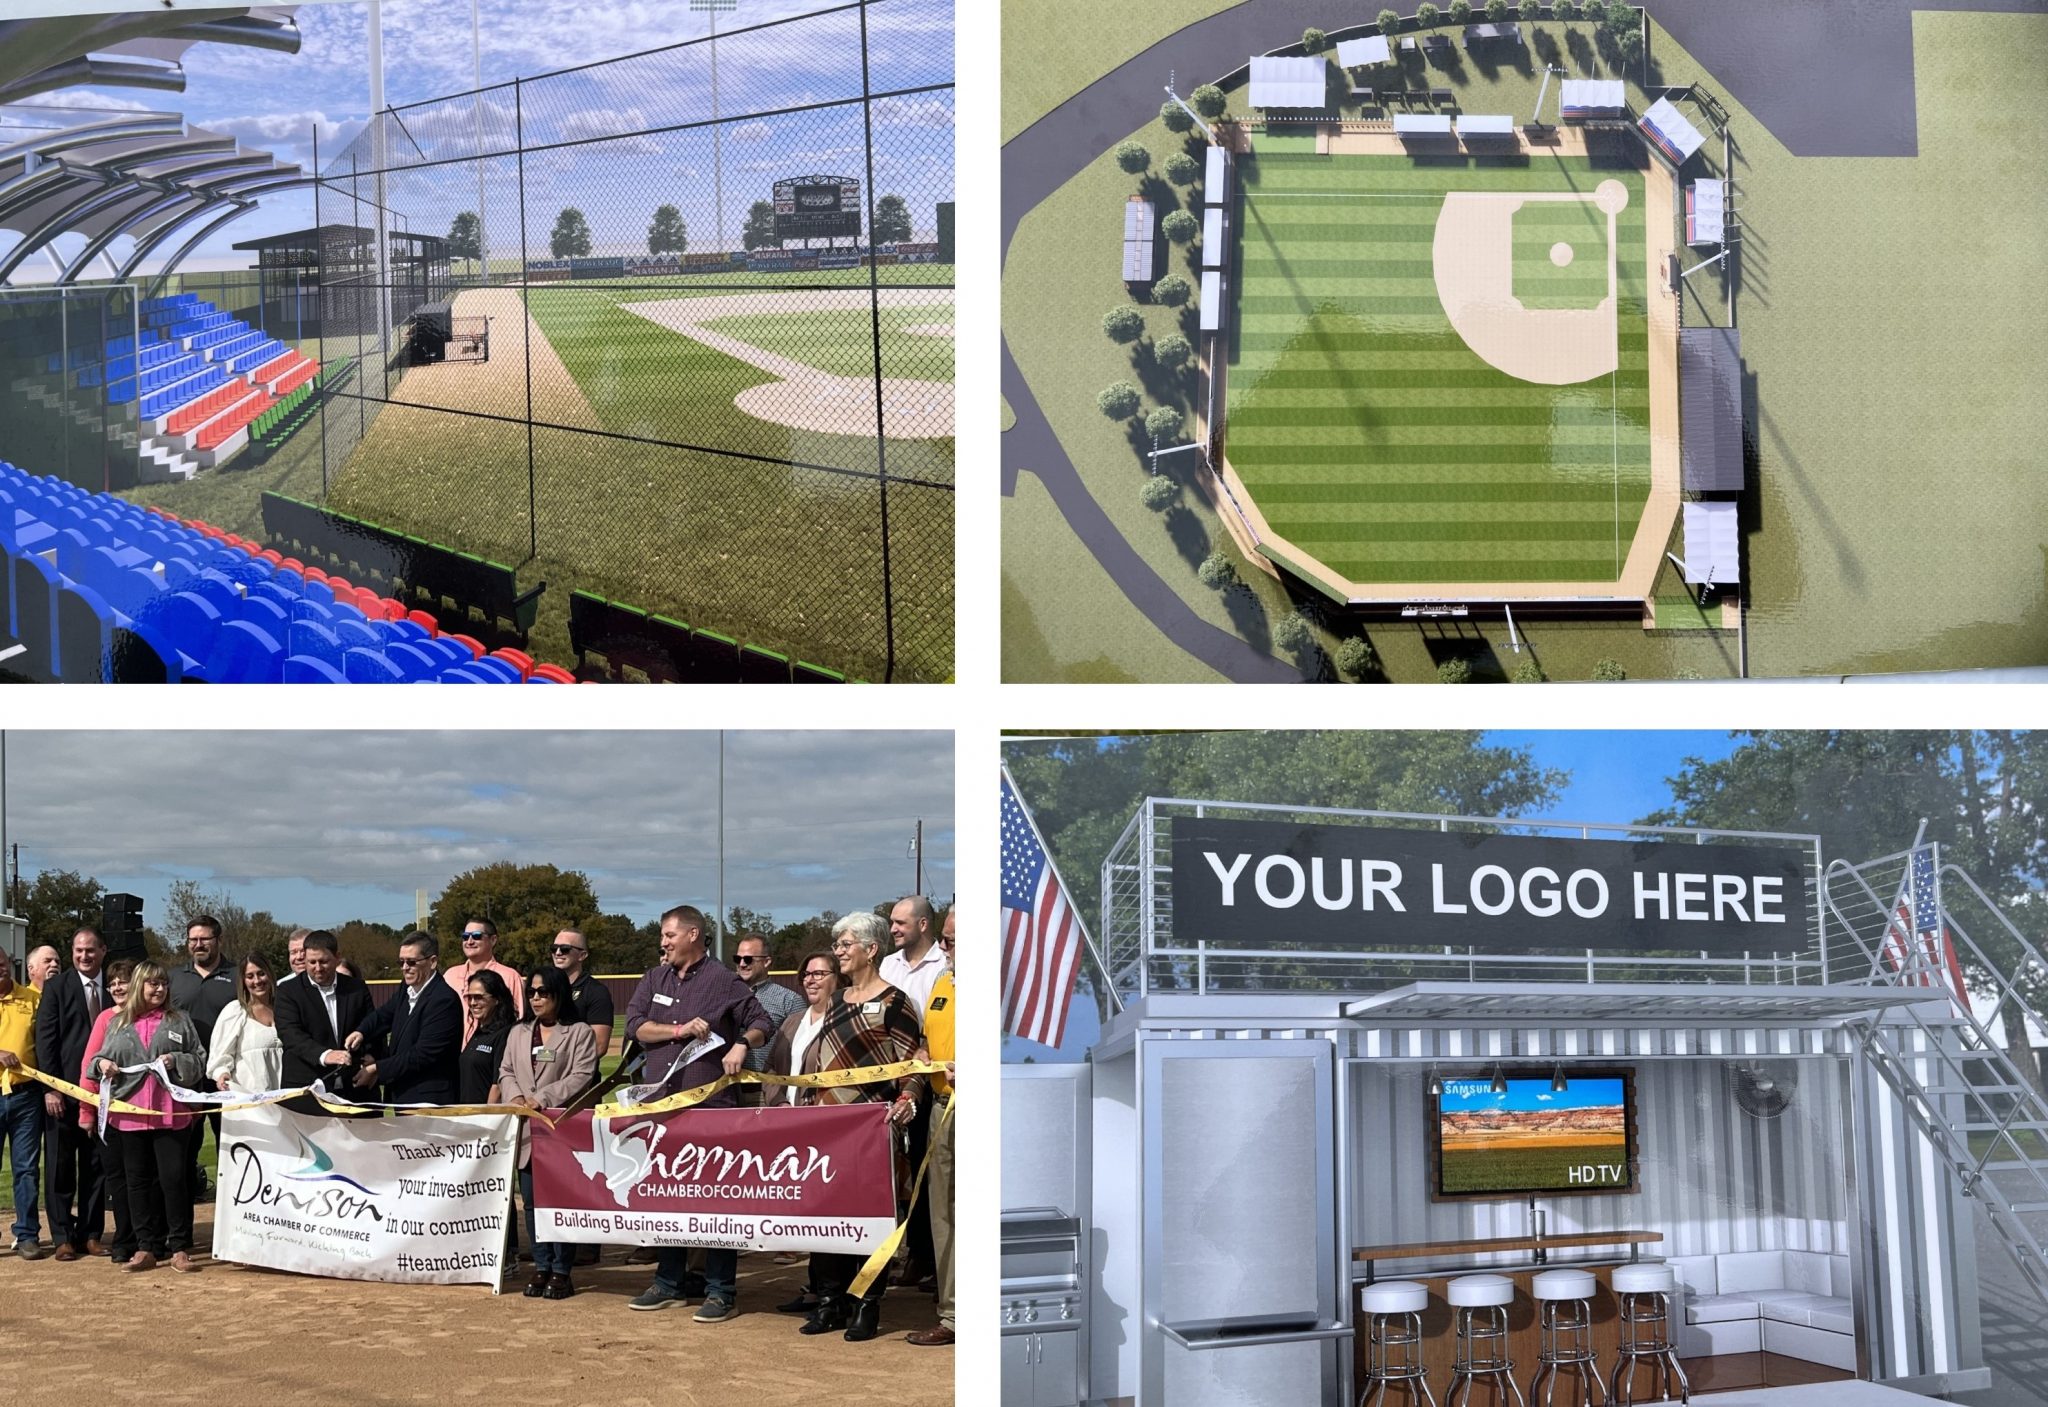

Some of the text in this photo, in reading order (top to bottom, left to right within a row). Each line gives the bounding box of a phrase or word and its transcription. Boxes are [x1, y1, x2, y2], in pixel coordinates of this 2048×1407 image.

[528, 260, 570, 269] NOBLEX
[1203, 852, 1786, 923] YOUR LOGO HERE
[1445, 1084, 1491, 1094] SAMSUN
[392, 1138, 498, 1163] Thank you for
[606, 1120, 836, 1190] Sherman
[230, 1142, 383, 1221] Denison
[398, 1178, 427, 1199] your
[243, 1212, 371, 1242] AREA CHAMBER OF COMMERCE
[385, 1212, 398, 1233] in
[401, 1219, 424, 1235] our
[554, 1212, 869, 1241] Building Business. Building Community.
[653, 1235, 749, 1248] shermanchamber.us
